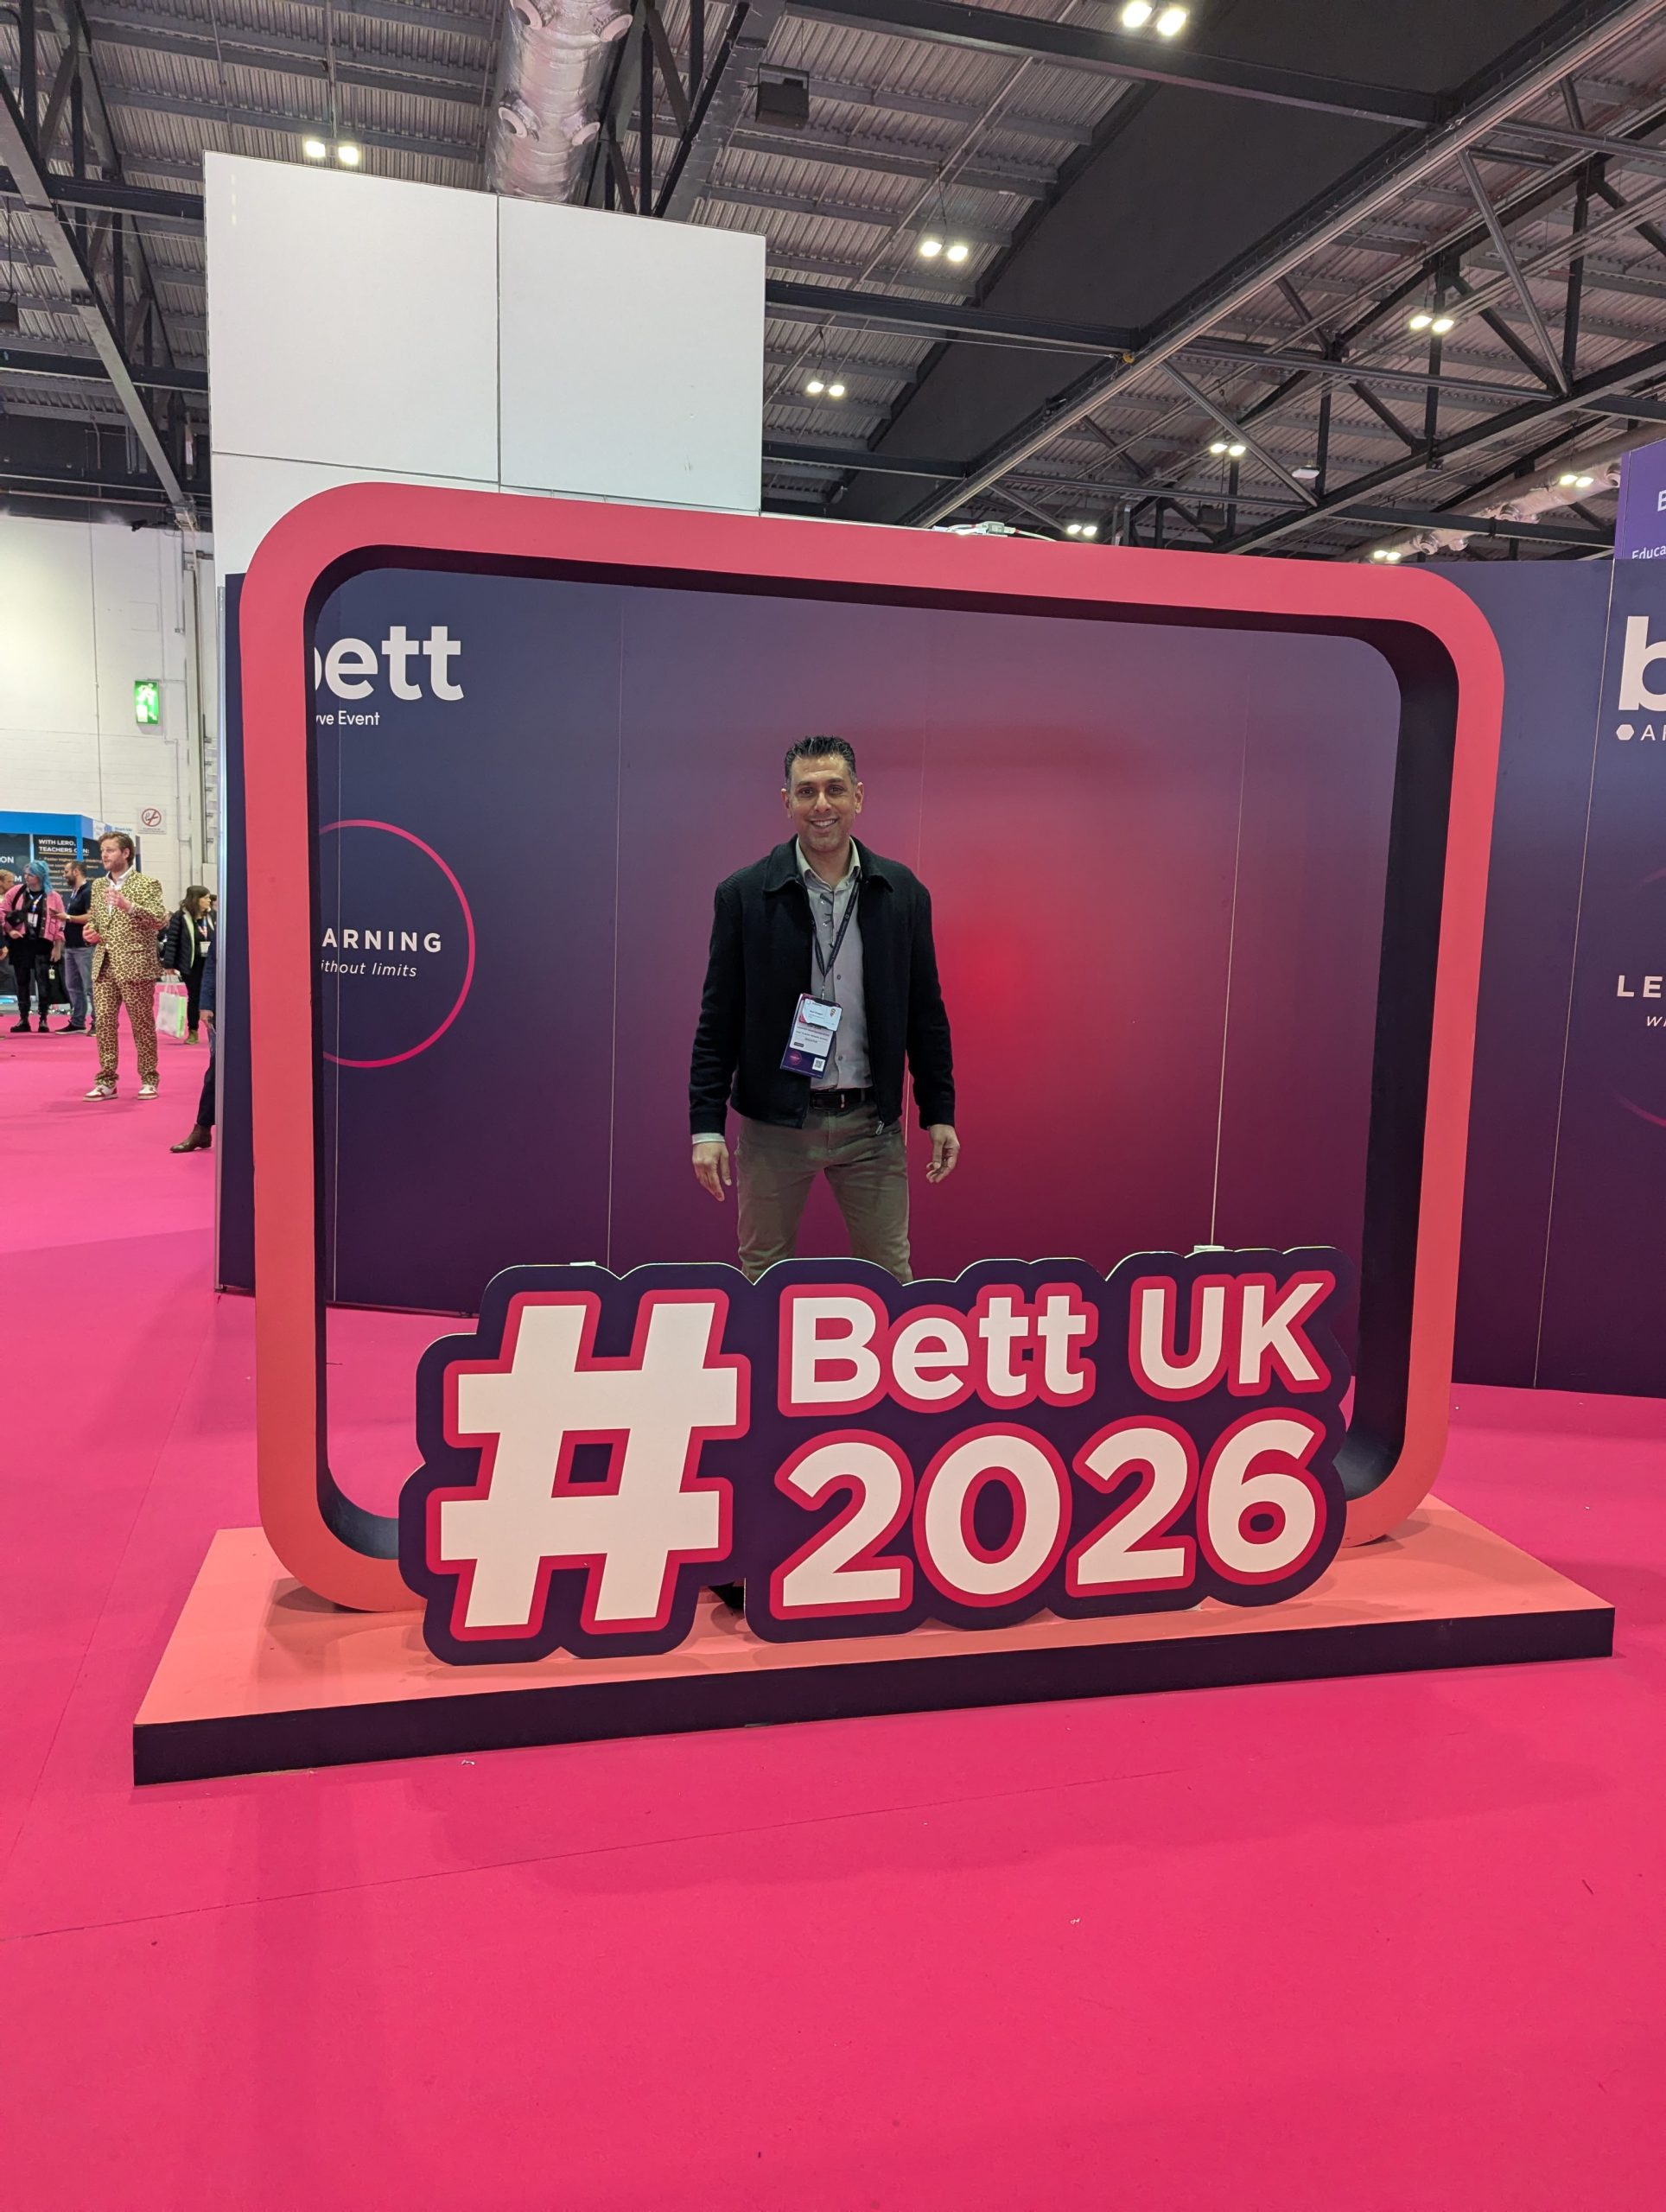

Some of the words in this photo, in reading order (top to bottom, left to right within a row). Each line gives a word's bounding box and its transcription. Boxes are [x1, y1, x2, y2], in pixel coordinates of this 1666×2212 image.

[314, 626, 464, 701] ett
[338, 710, 380, 726] Event
[321, 928, 442, 953] ARNING
[372, 963, 417, 977] limits
[790, 1295, 1086, 1404] Bett
[1140, 1282, 1324, 1389] UK
[782, 1419, 1318, 1607] 2026
